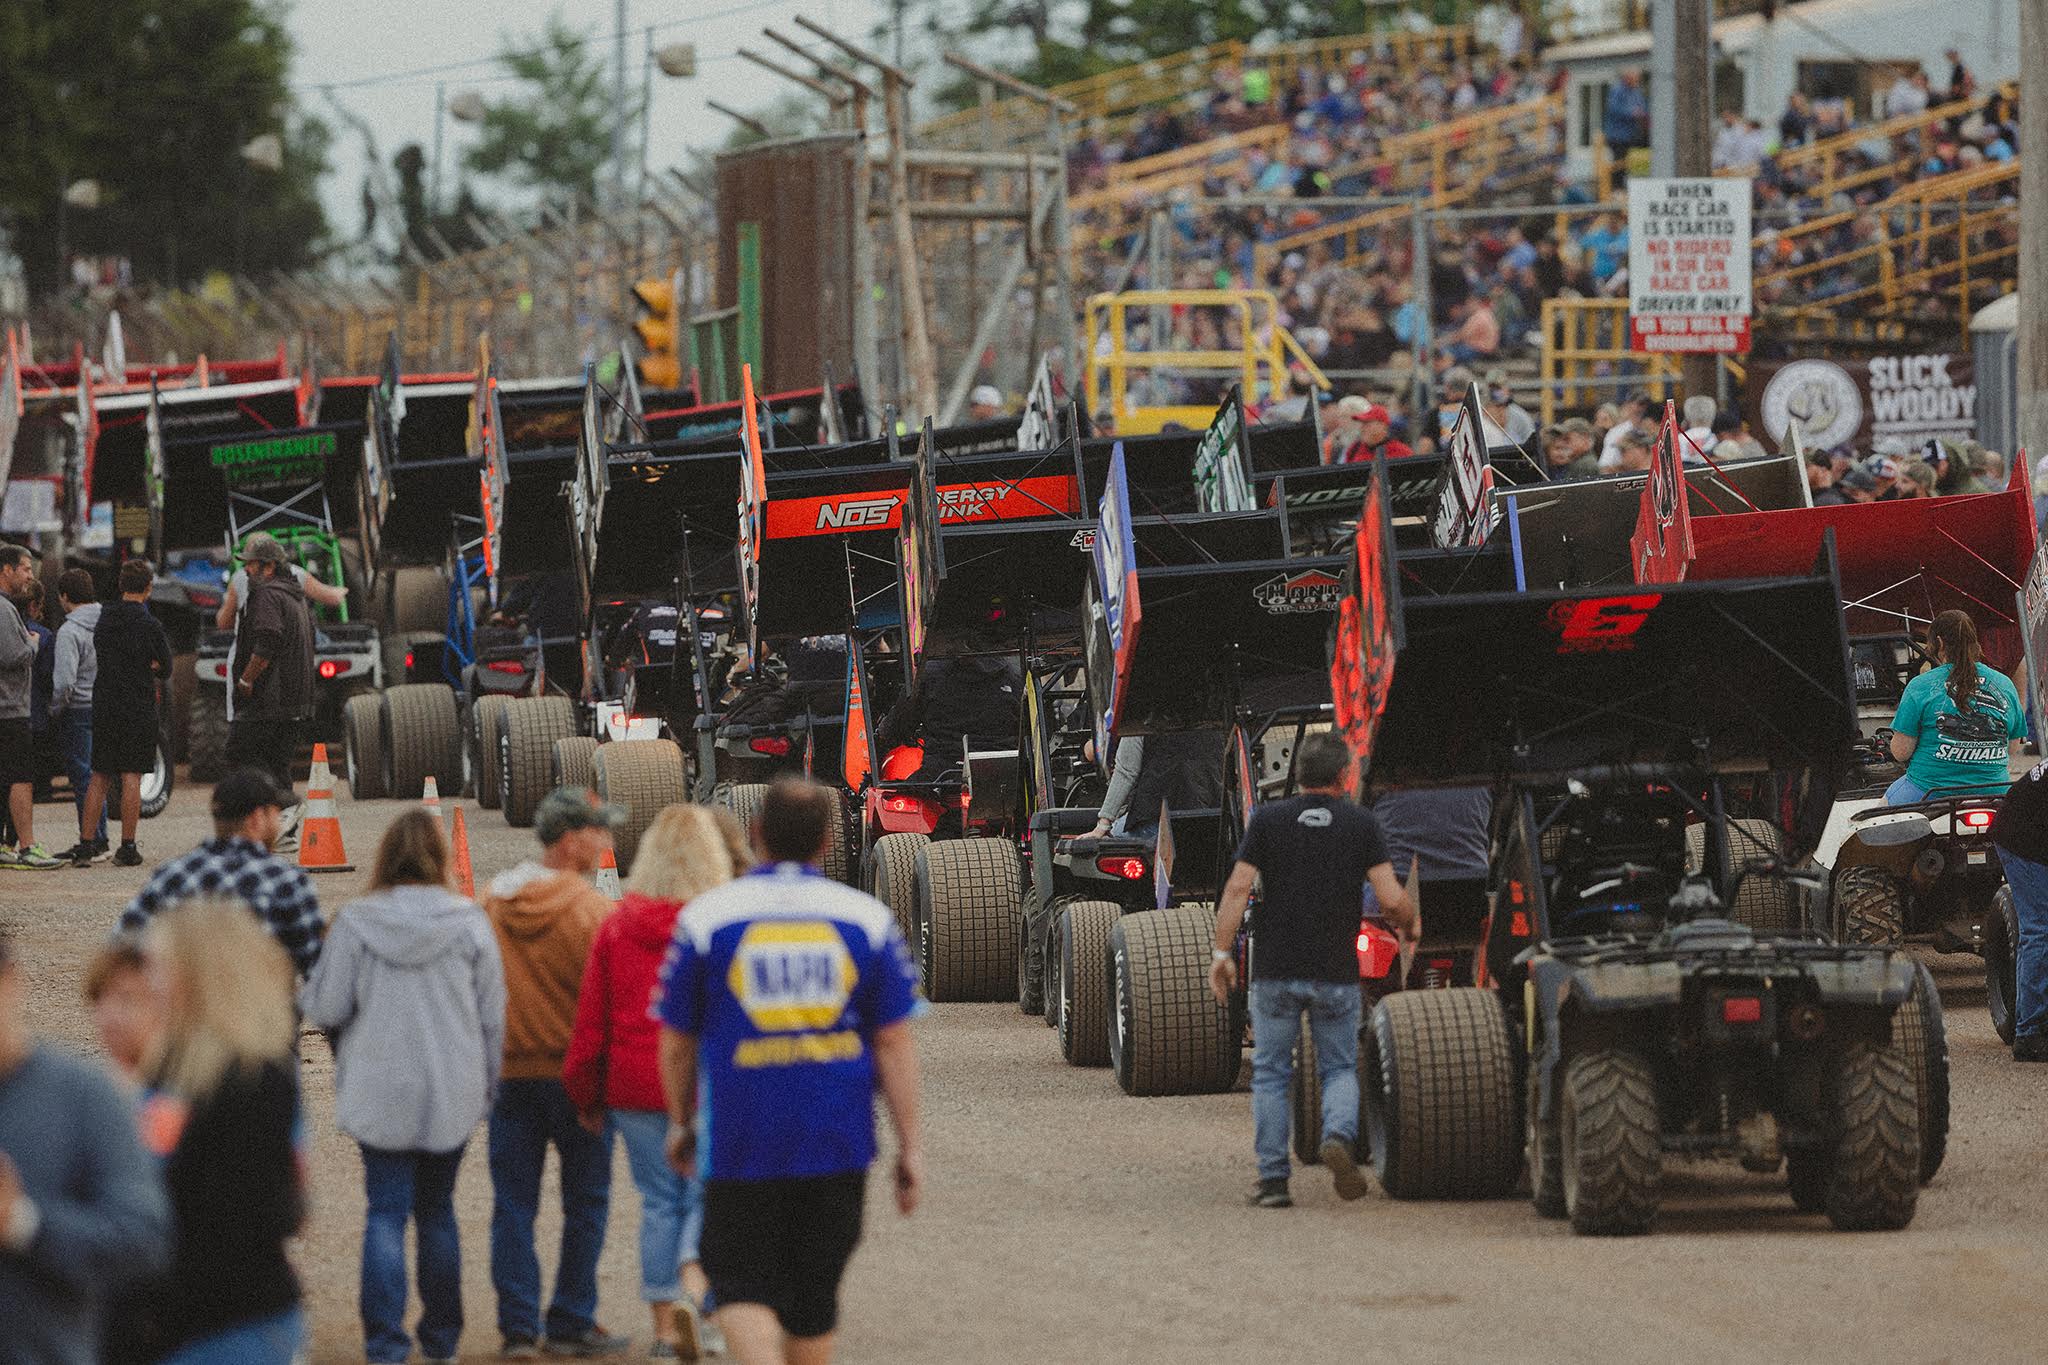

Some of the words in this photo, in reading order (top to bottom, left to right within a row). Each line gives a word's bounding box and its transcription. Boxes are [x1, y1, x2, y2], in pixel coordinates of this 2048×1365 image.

[1667, 184, 1713, 197] WHEN
[1649, 201, 1689, 216] RACE
[1696, 201, 1728, 216] CAR
[1644, 220, 1659, 234] IS
[1665, 220, 1735, 235] STARTED
[1647, 240, 1669, 255] NO
[1674, 240, 1732, 255] RIDERS
[1654, 258, 1671, 272] IN
[1676, 258, 1698, 272] OR
[1704, 258, 1725, 272] ON
[1650, 276, 1691, 291] RACE
[1697, 276, 1729, 291] CAR
[1637, 296, 1696, 311] DRIVER
[1701, 296, 1741, 311] ONLY
[1868, 354, 1952, 389] SLICK
[816, 496, 897, 529] NOS
